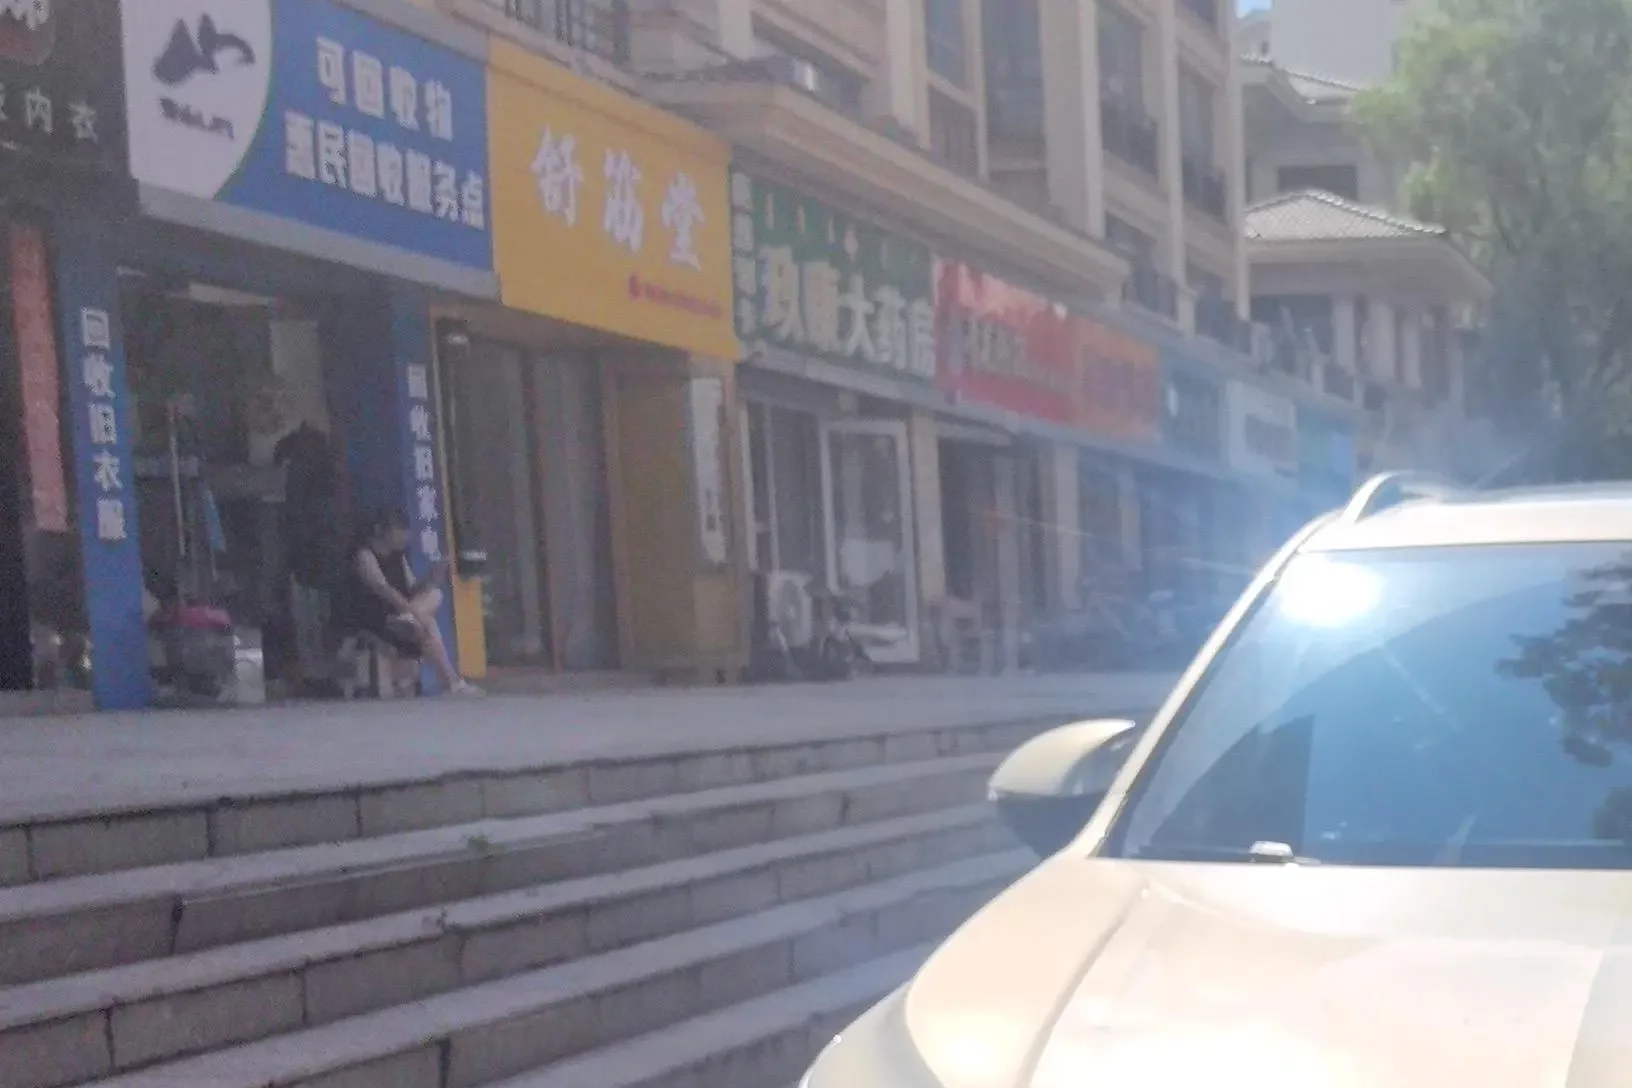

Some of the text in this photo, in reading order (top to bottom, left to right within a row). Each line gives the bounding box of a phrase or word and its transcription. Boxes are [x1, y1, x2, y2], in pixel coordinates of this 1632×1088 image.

[0, 83, 99, 145] 内衣
[315, 36, 454, 142] 可回收物
[284, 109, 485, 231] 惠民回收服务点
[80, 306, 126, 540] 回收旧衣服
